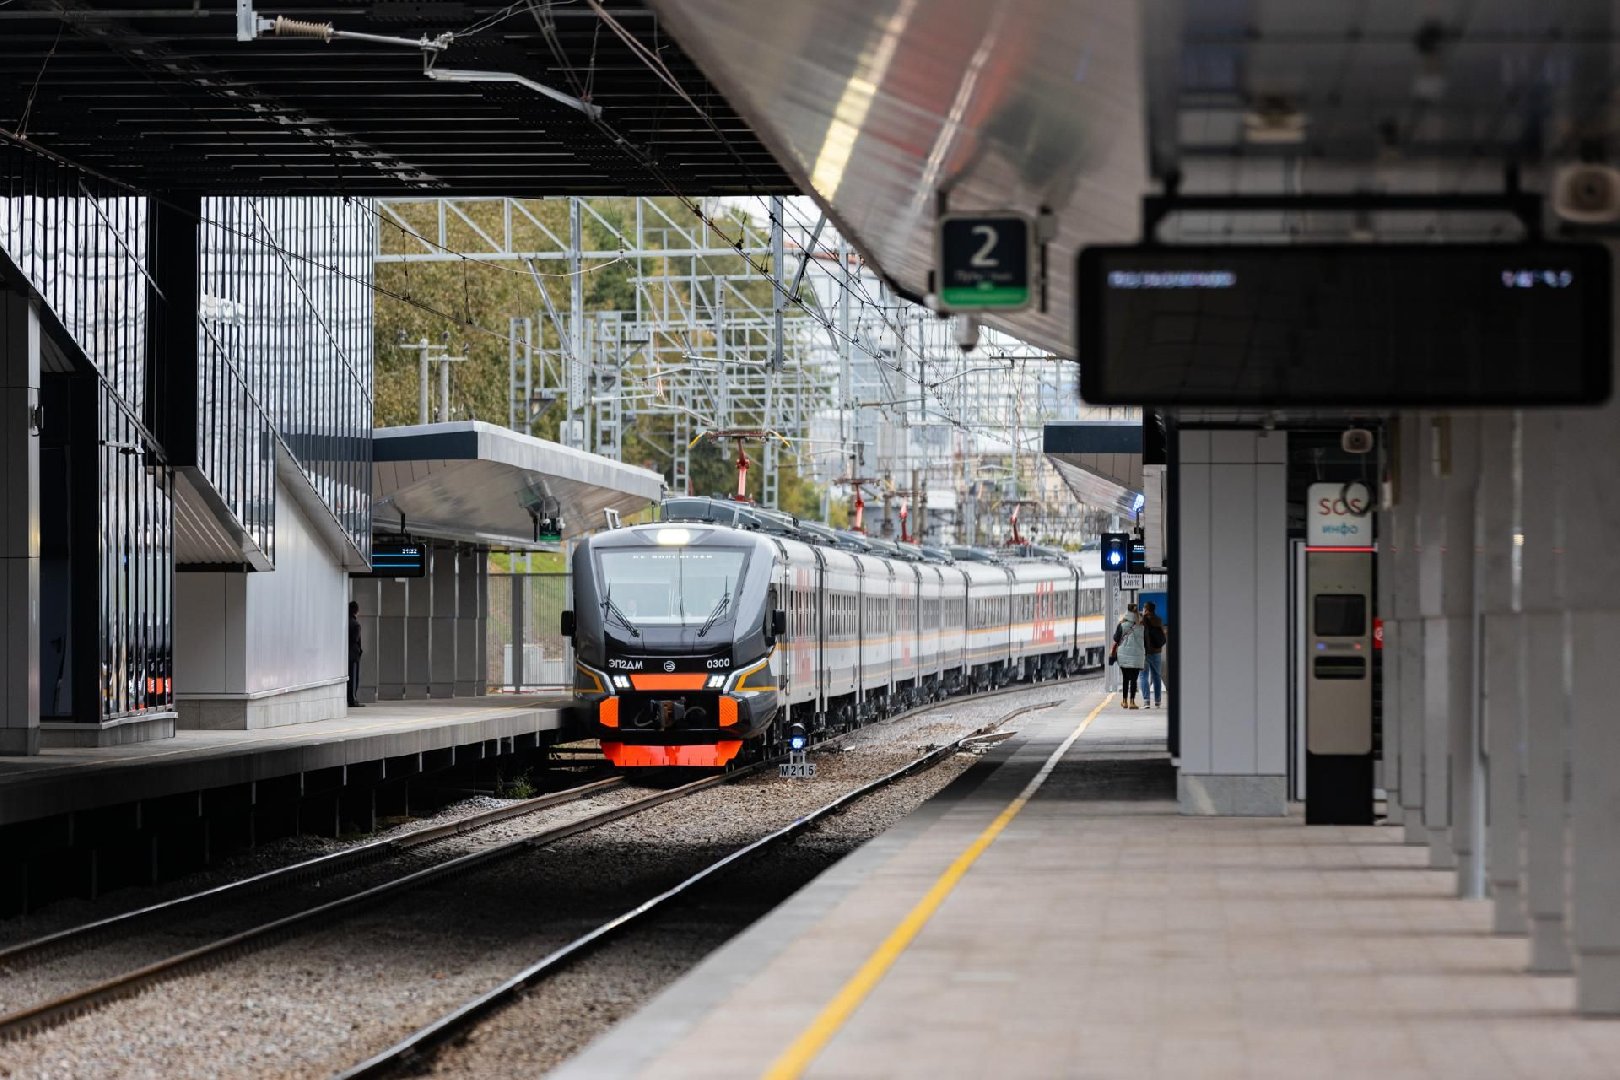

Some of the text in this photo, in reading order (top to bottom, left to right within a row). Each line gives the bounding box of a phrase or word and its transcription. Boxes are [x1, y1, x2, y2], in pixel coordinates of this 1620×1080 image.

[970, 225, 1000, 267] 2
[608, 657, 730, 670] ЭП2ДМ 0300
[781, 765, 814, 776] М215
